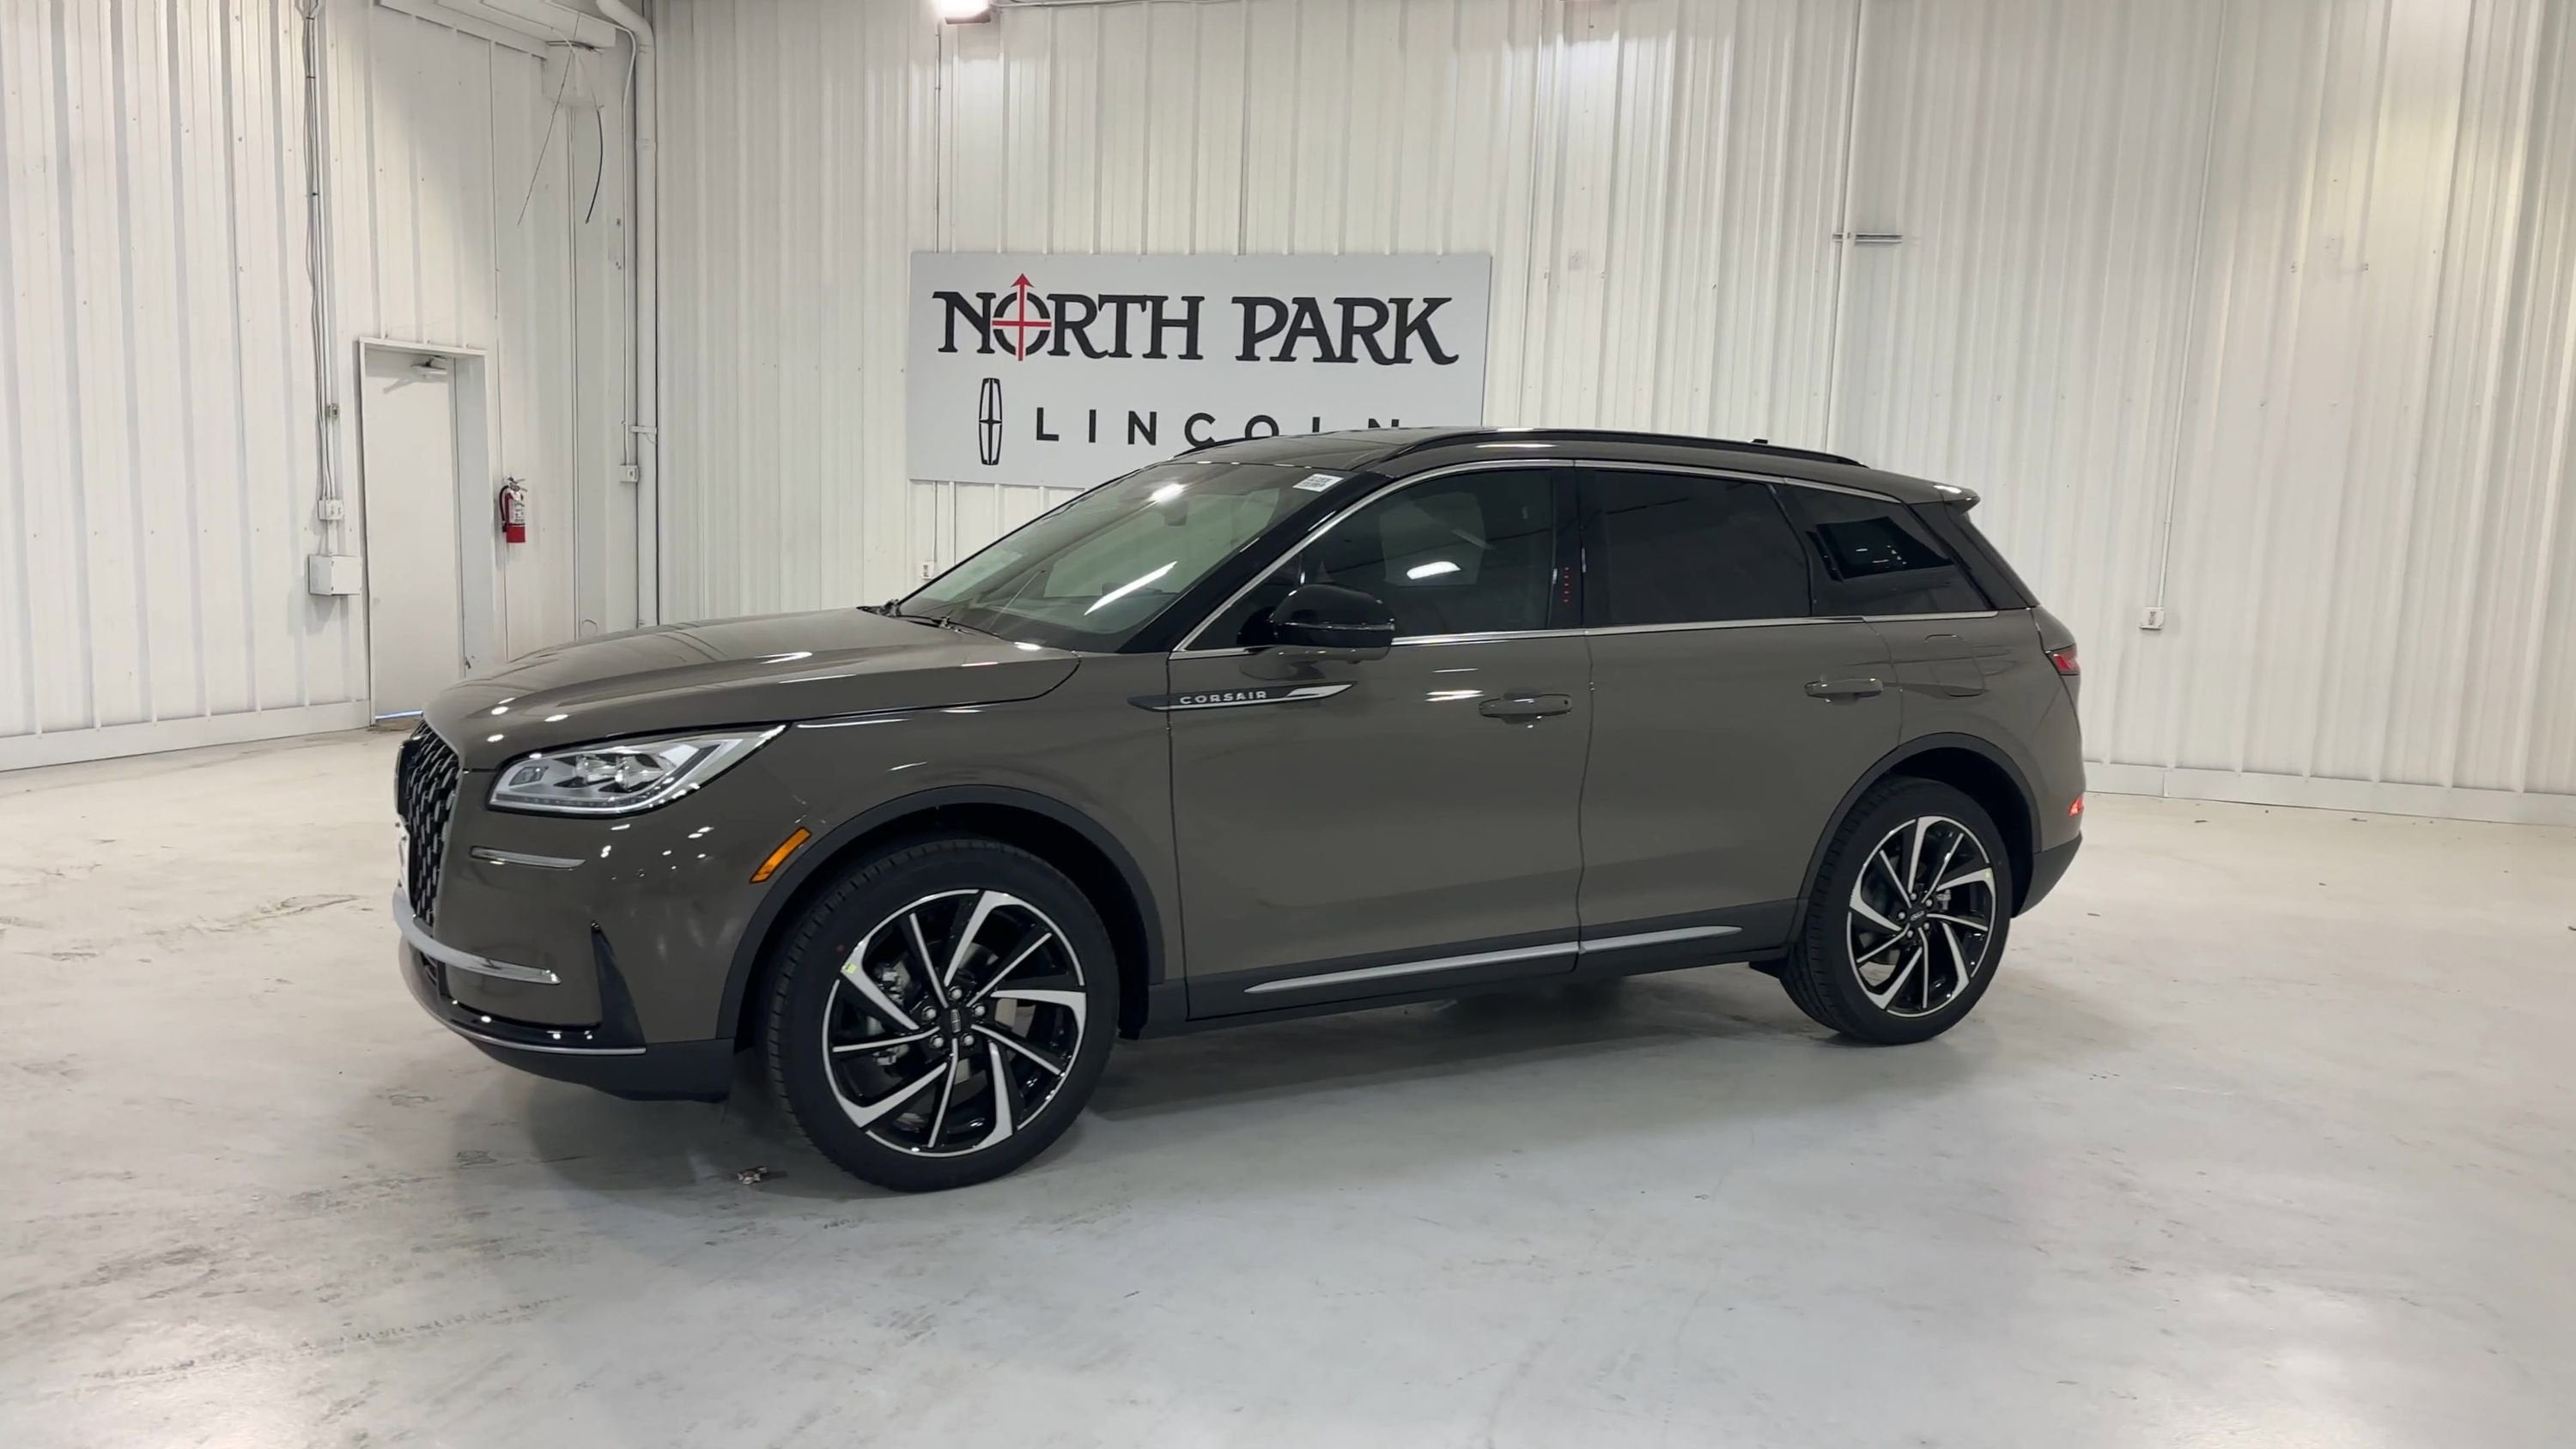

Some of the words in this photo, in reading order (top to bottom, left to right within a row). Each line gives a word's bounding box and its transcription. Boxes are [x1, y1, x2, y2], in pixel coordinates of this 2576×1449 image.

[933, 290, 1206, 361] NORTH
[1230, 295, 1460, 366] PARK
[1036, 407, 1400, 448] LINCO
[1179, 690, 1267, 705] CORSAIR
